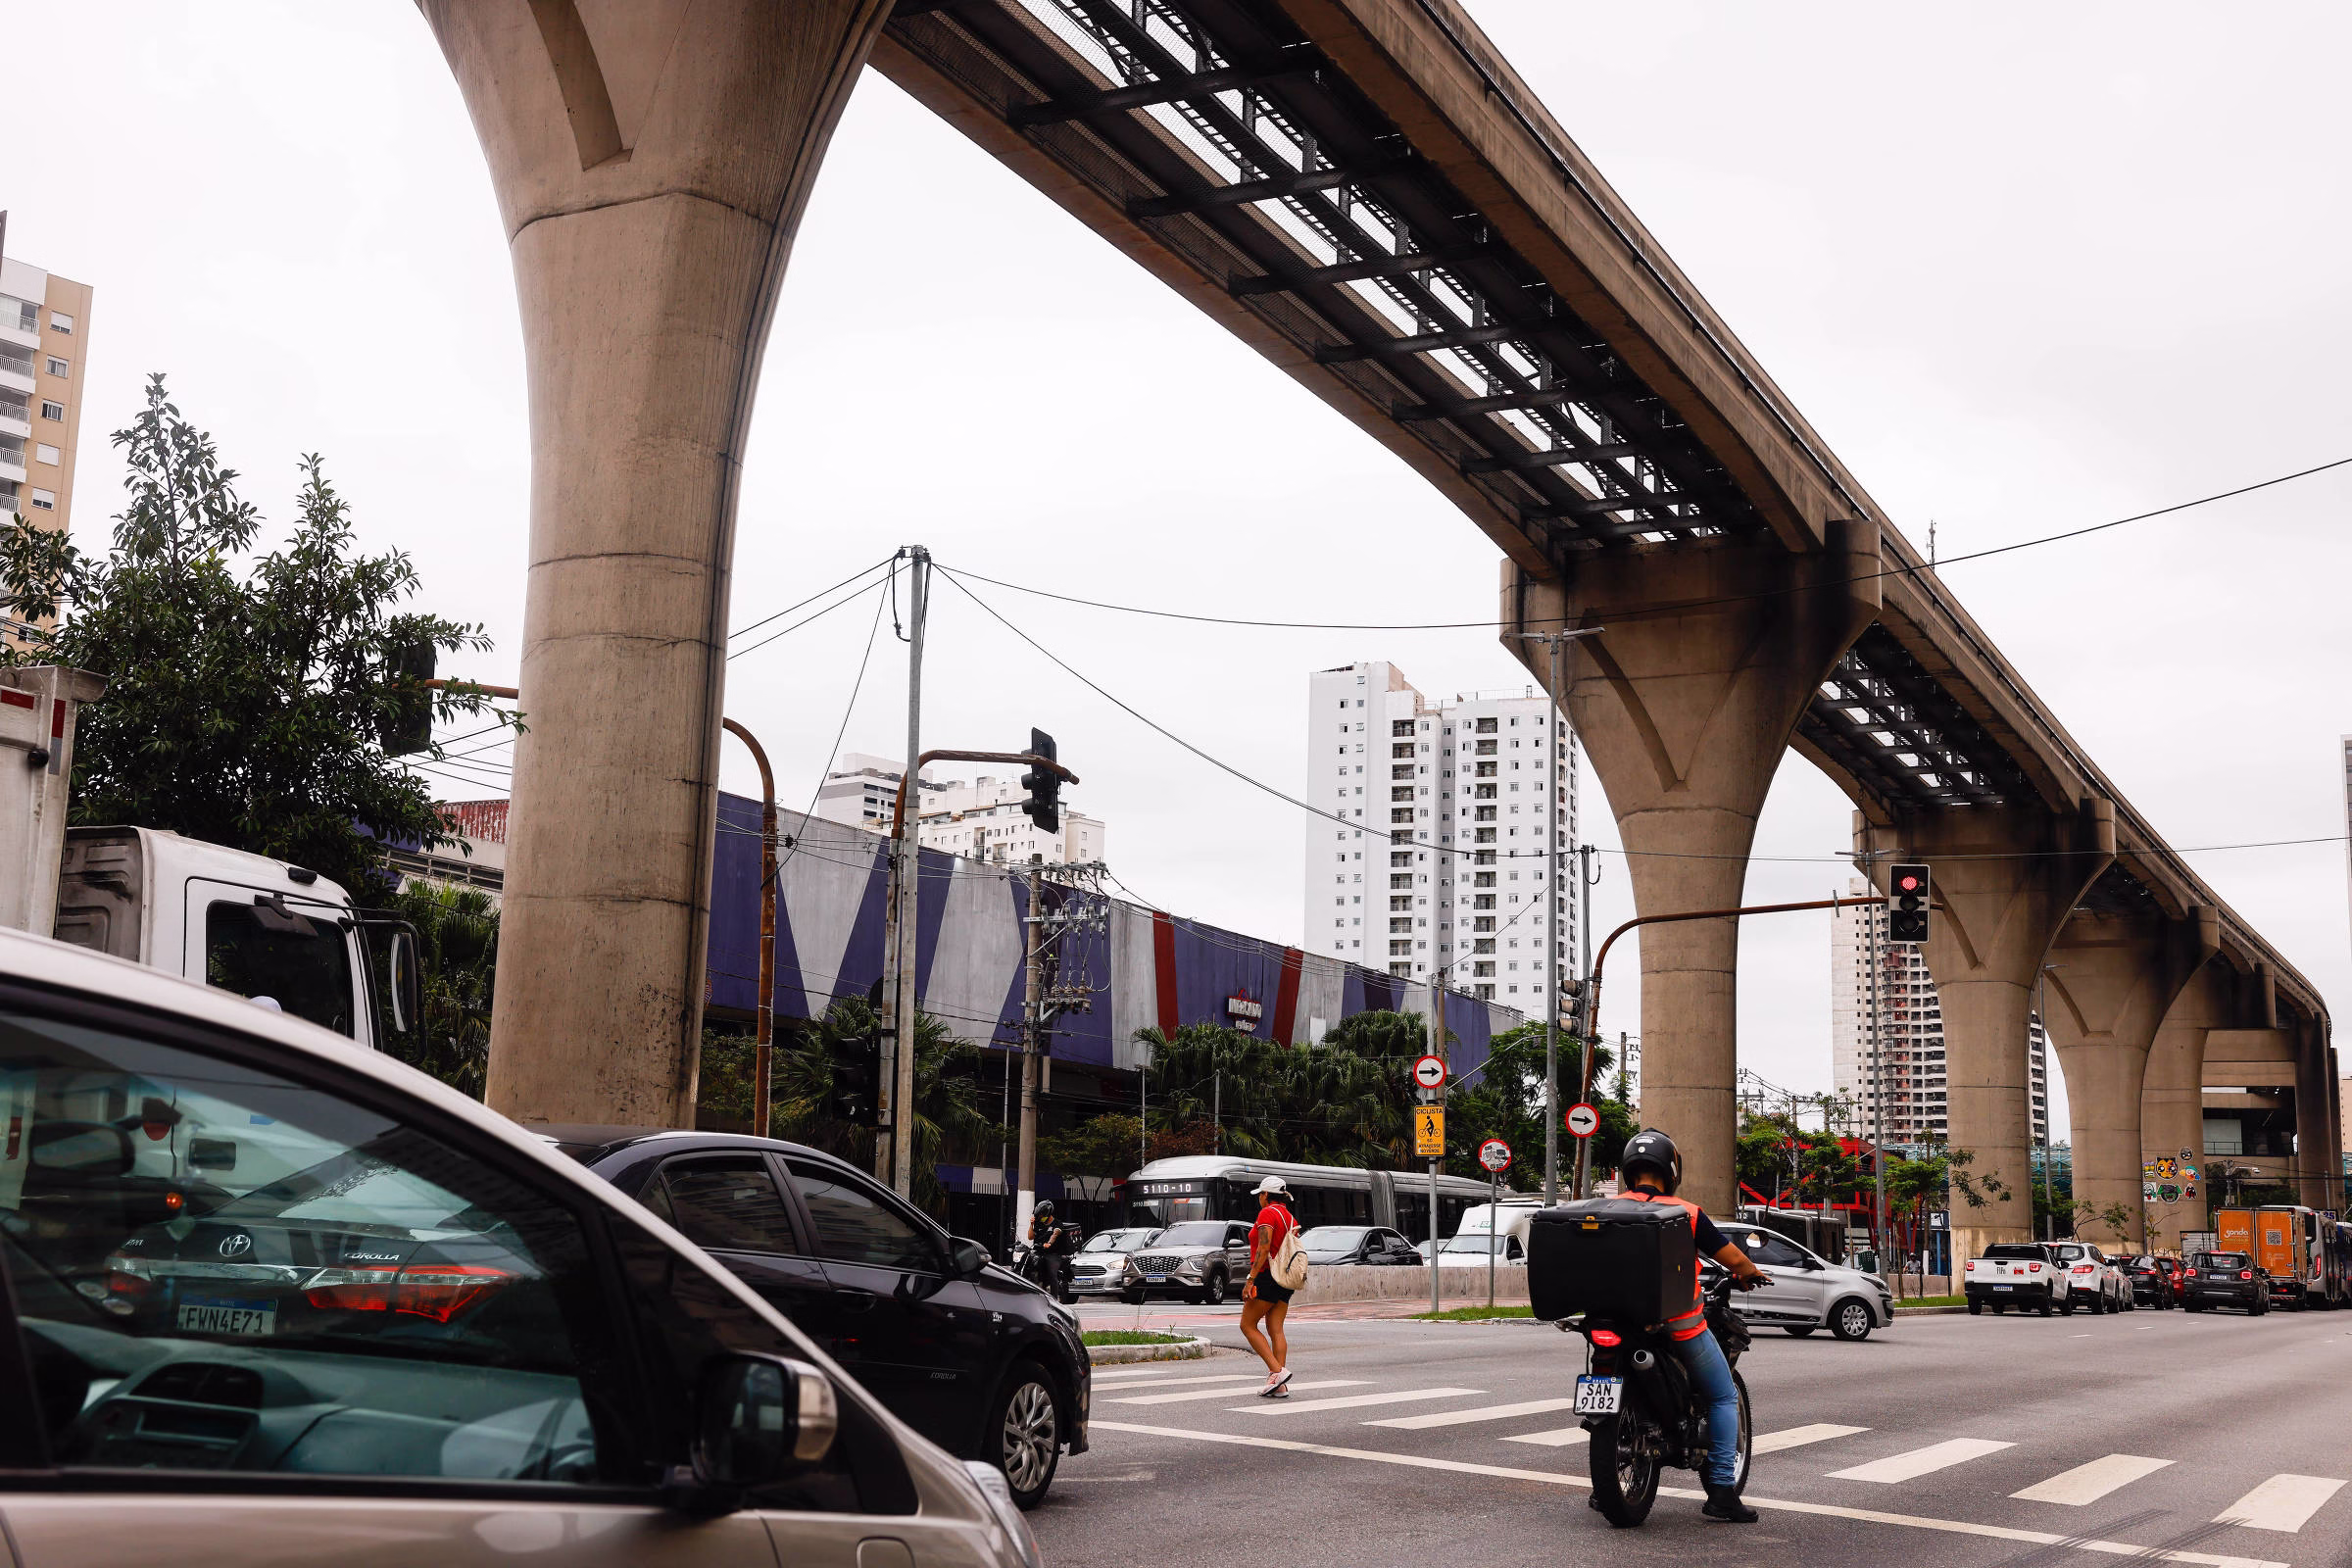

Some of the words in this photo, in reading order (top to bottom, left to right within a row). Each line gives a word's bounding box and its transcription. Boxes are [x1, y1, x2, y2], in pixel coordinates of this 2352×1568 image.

[344, 1251, 400, 1261] COROLLA
[186, 1307, 264, 1333] FWN4E71
[1586, 1383, 1612, 1396] SAN
[1581, 1396, 1614, 1409] 9182
